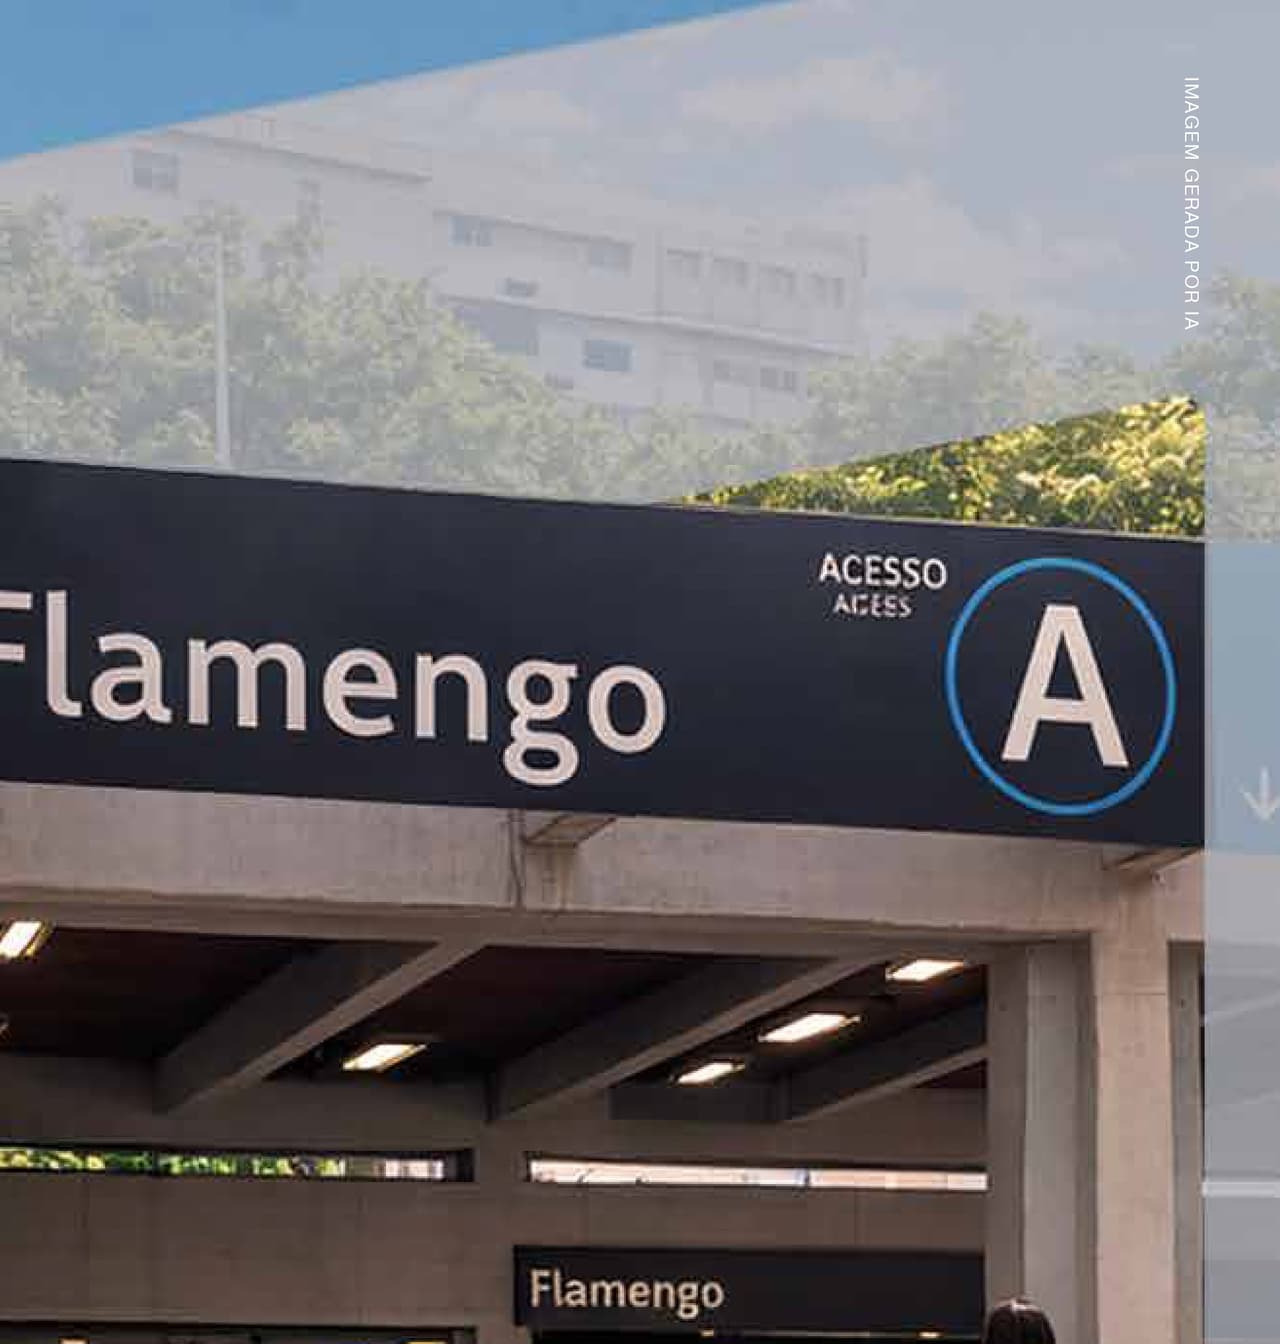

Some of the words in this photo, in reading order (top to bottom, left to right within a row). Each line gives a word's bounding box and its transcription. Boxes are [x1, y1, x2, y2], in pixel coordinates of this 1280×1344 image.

[819, 552, 947, 591] ACESSO
[1001, 603, 1130, 768] A
[530, 1268, 726, 1321] Flamengo
